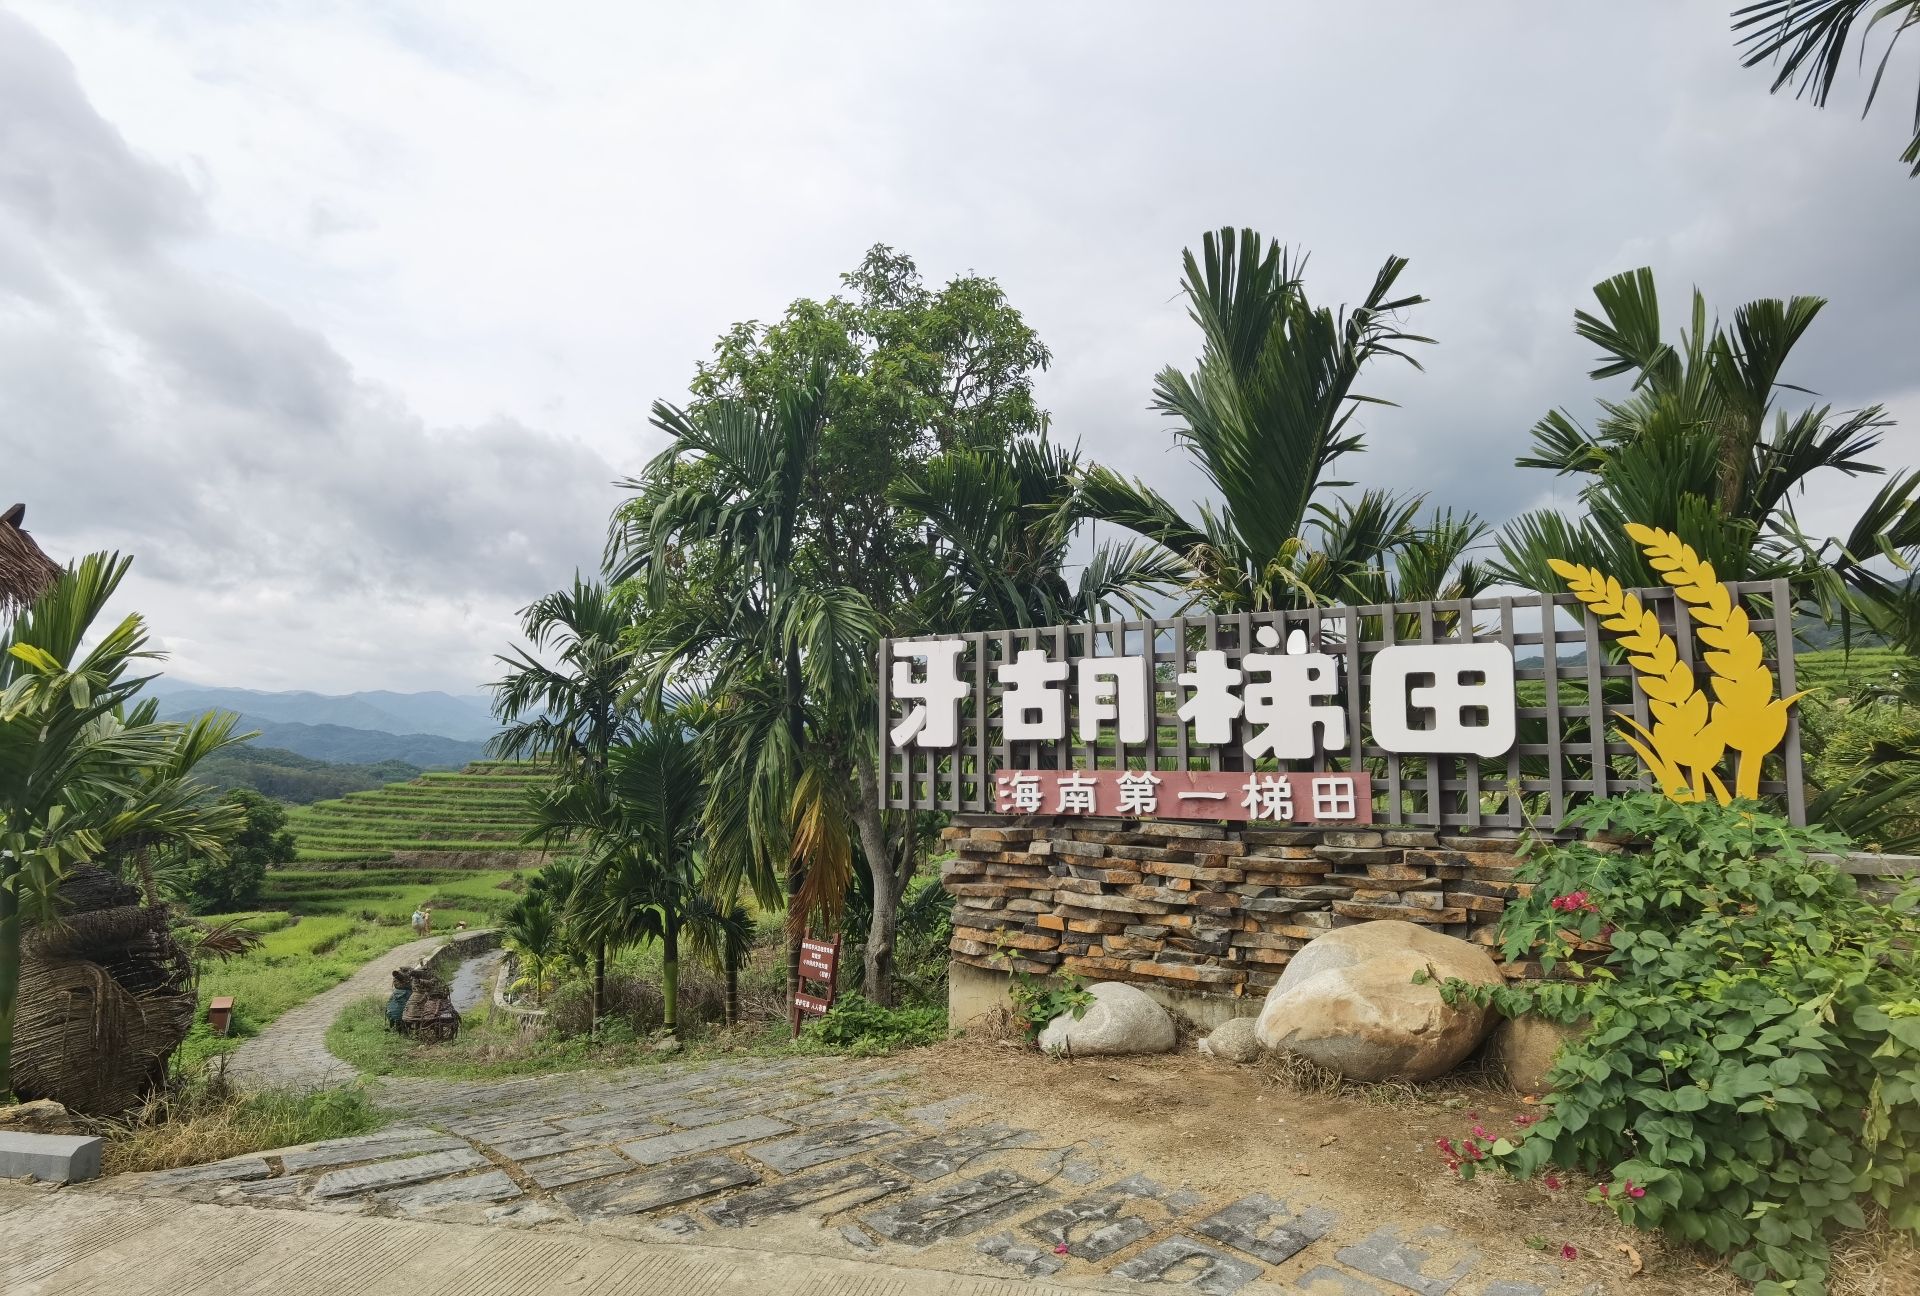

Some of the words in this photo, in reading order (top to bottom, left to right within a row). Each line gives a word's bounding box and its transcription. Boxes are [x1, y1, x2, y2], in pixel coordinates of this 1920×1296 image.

[889, 625, 1517, 760] 牙胡梯田
[998, 772, 1356, 821] 海南第一梯田
